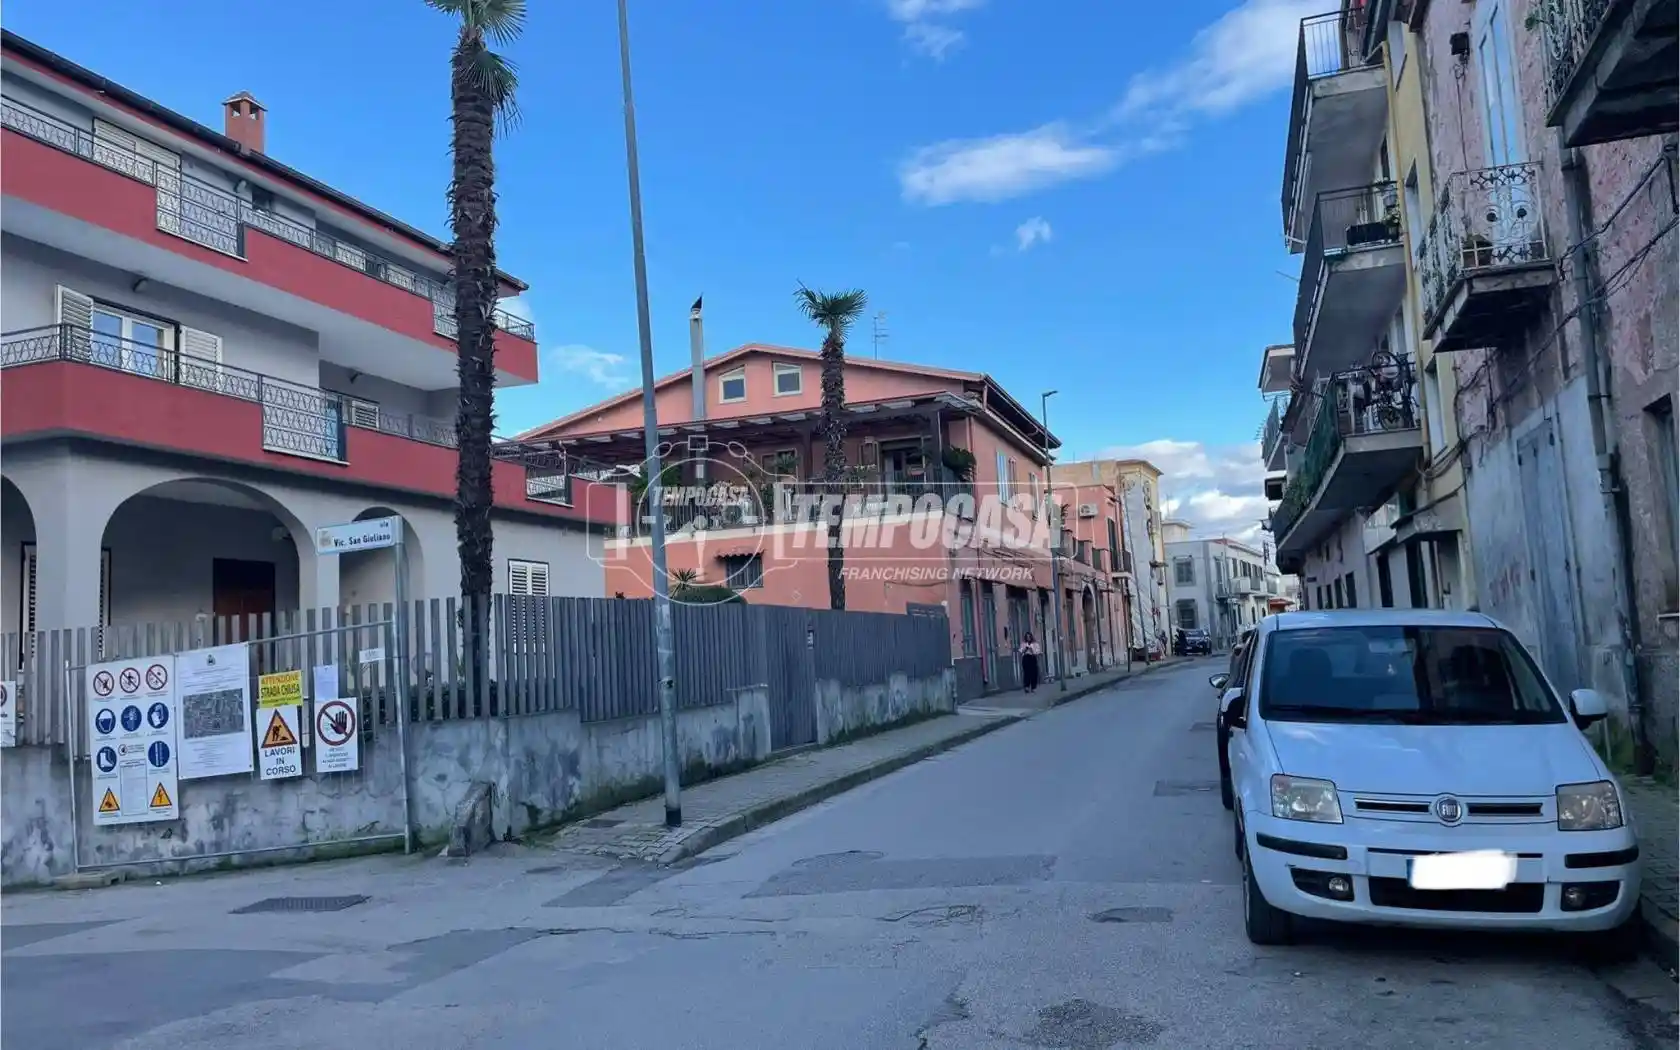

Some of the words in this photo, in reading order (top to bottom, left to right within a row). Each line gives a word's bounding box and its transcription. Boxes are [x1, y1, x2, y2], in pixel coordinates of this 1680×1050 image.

[333, 537, 346, 548] Vic.
[348, 535, 361, 546] San
[362, 532, 391, 544] Giuliano
[261, 674, 300, 685] ATTENZIONE
[260, 685, 281, 698] STRADA
[281, 683, 300, 696] CHIUSA
[264, 746, 296, 758] LAVORI
[275, 756, 285, 765] IN
[265, 764, 297, 777] CORSO
